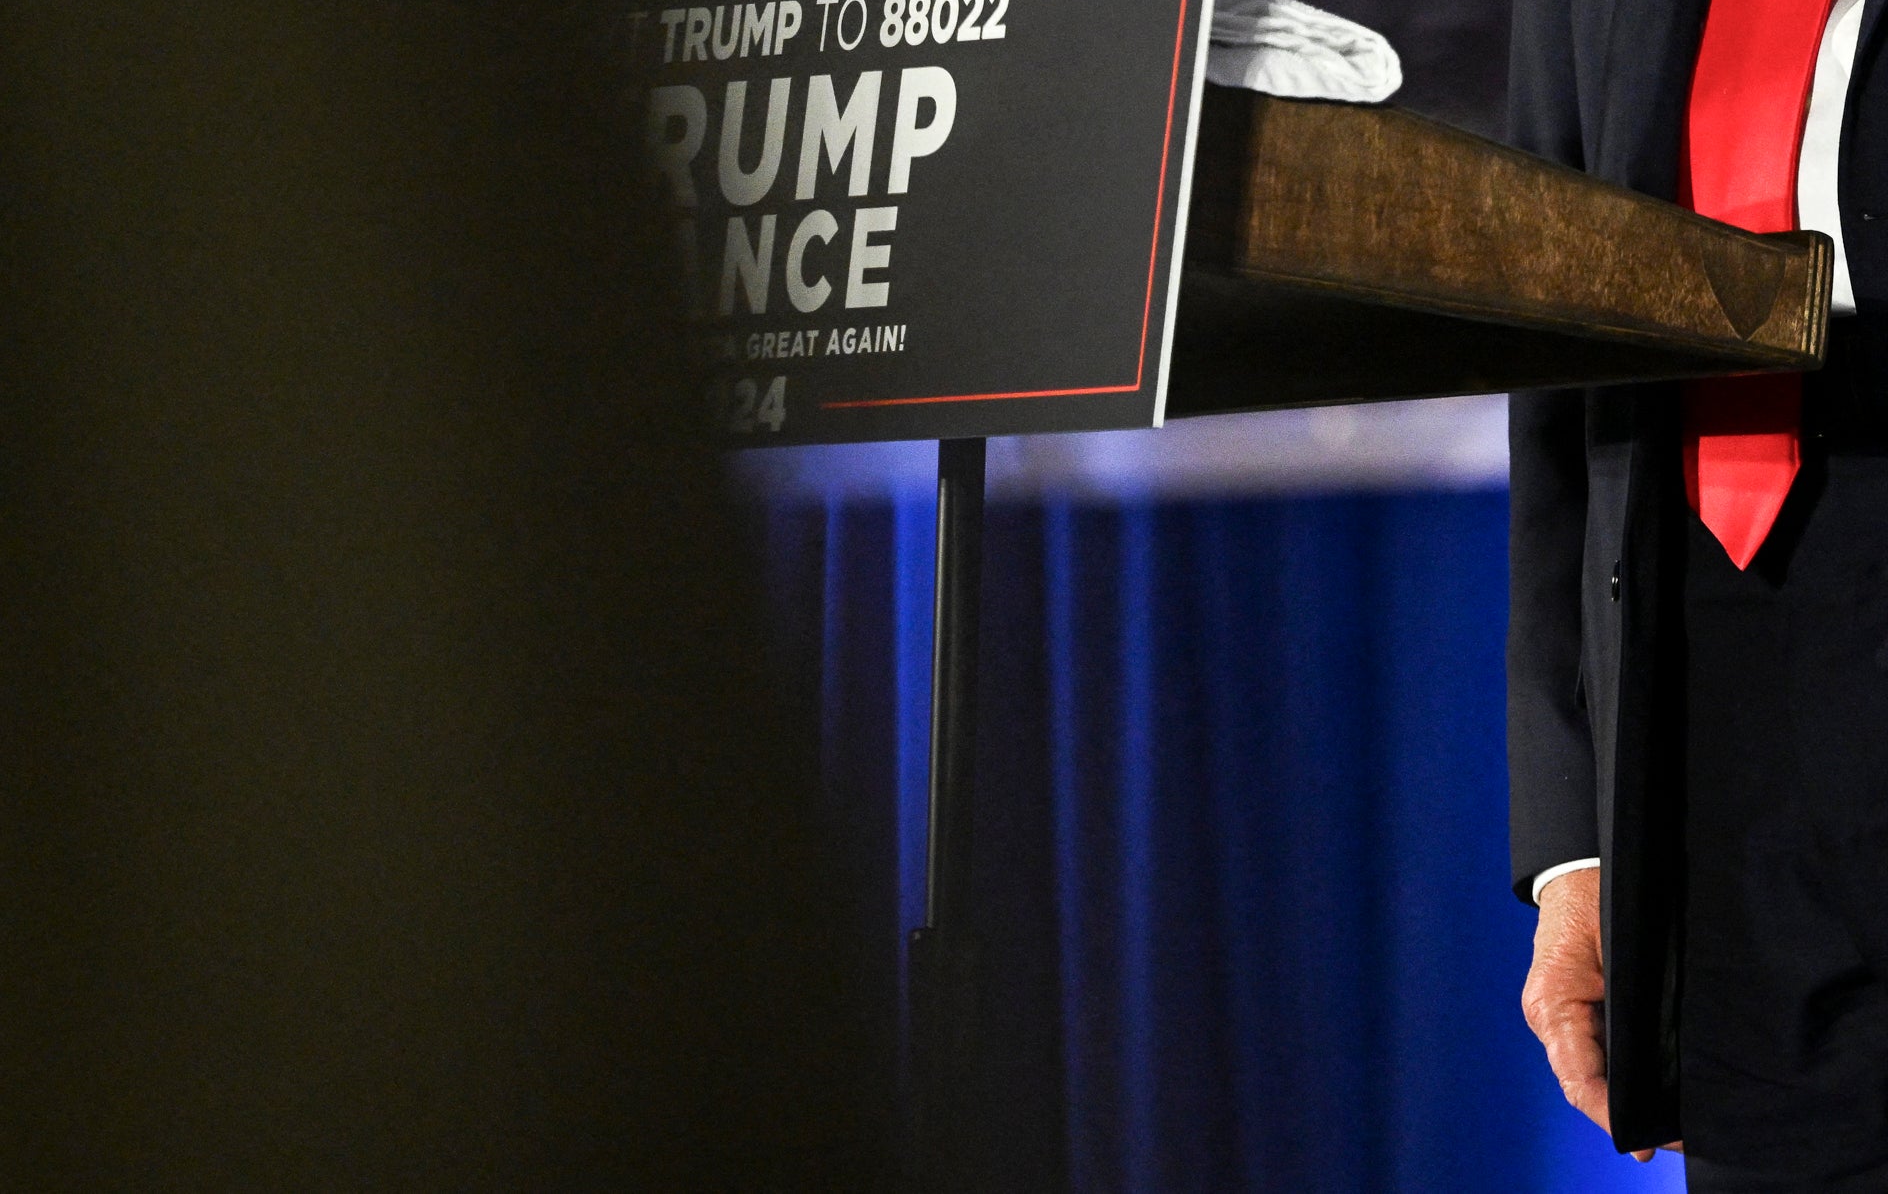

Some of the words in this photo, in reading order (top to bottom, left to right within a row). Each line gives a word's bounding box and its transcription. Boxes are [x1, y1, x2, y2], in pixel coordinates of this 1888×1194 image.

[660, 0, 802, 64] TRUMP
[646, 65, 957, 206] RUMP
[680, 206, 898, 314] NCE
[746, 329, 819, 358] GREAT
[825, 324, 907, 356] AGAIN!
